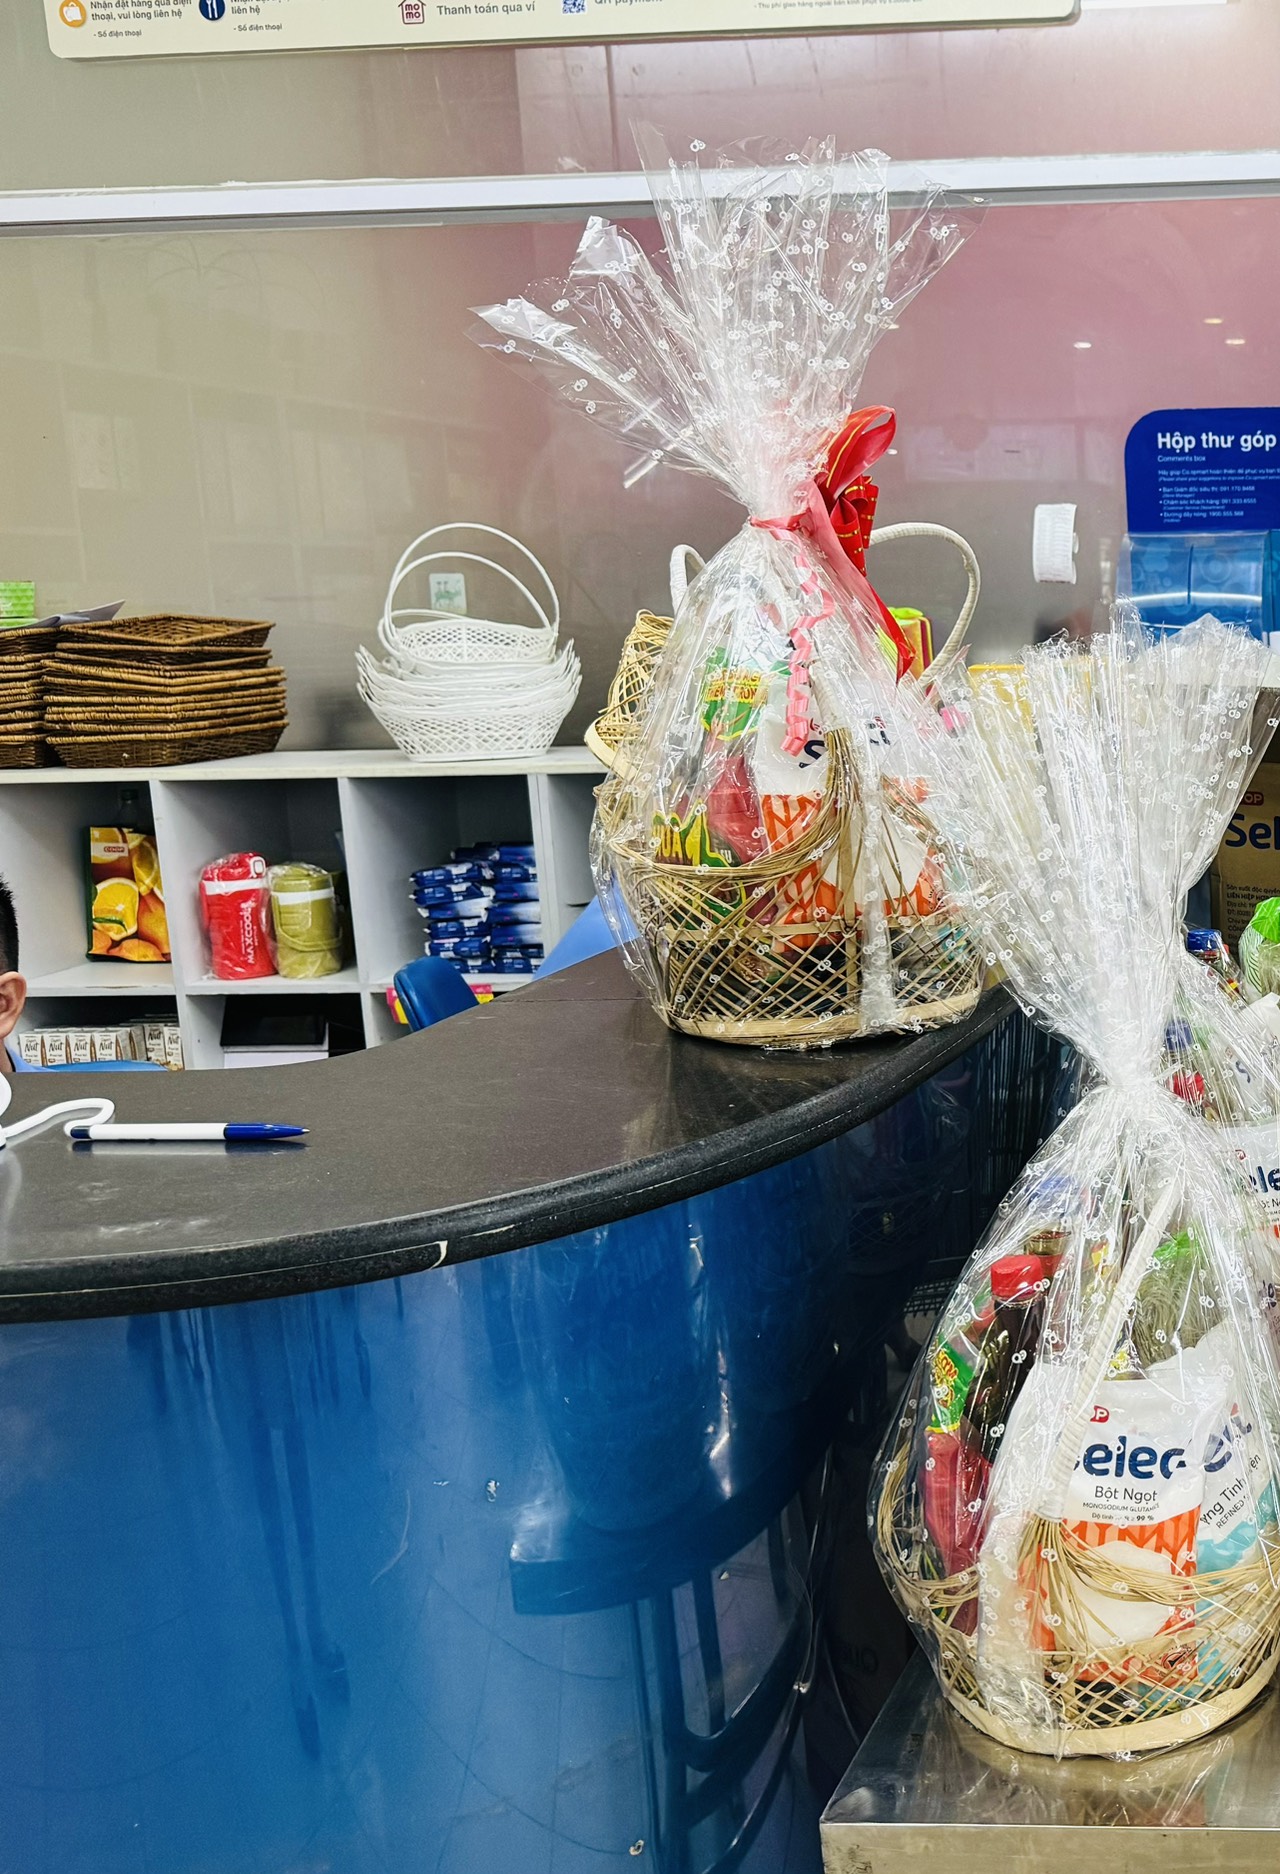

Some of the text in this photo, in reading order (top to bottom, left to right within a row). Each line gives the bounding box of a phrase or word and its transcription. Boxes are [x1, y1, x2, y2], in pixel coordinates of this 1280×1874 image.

[231, 5, 261, 15] liên hệ
[405, 3, 420, 11] mo
[437, 1, 536, 15] Thanh toán qua ví
[117, 11, 131, 19] vui
[133, 10, 152, 20] lòng
[154, 9, 169, 18] liên
[171, 9, 182, 19] hệ
[405, 11, 421, 19] mo
[1157, 431, 1196, 453] Hộp
[1200, 431, 1235, 449] thư
[1240, 430, 1277, 452] góp
[1157, 455, 1193, 463] Comments
[1243, 793, 1263, 804] OP
[1075, 1435, 1187, 1480] elec
[1094, 1485, 1158, 1505] Bột Ngọt
[1082, 1502, 1128, 1512] MONOSODIUM
[1216, 1501, 1245, 1529] REFINED
